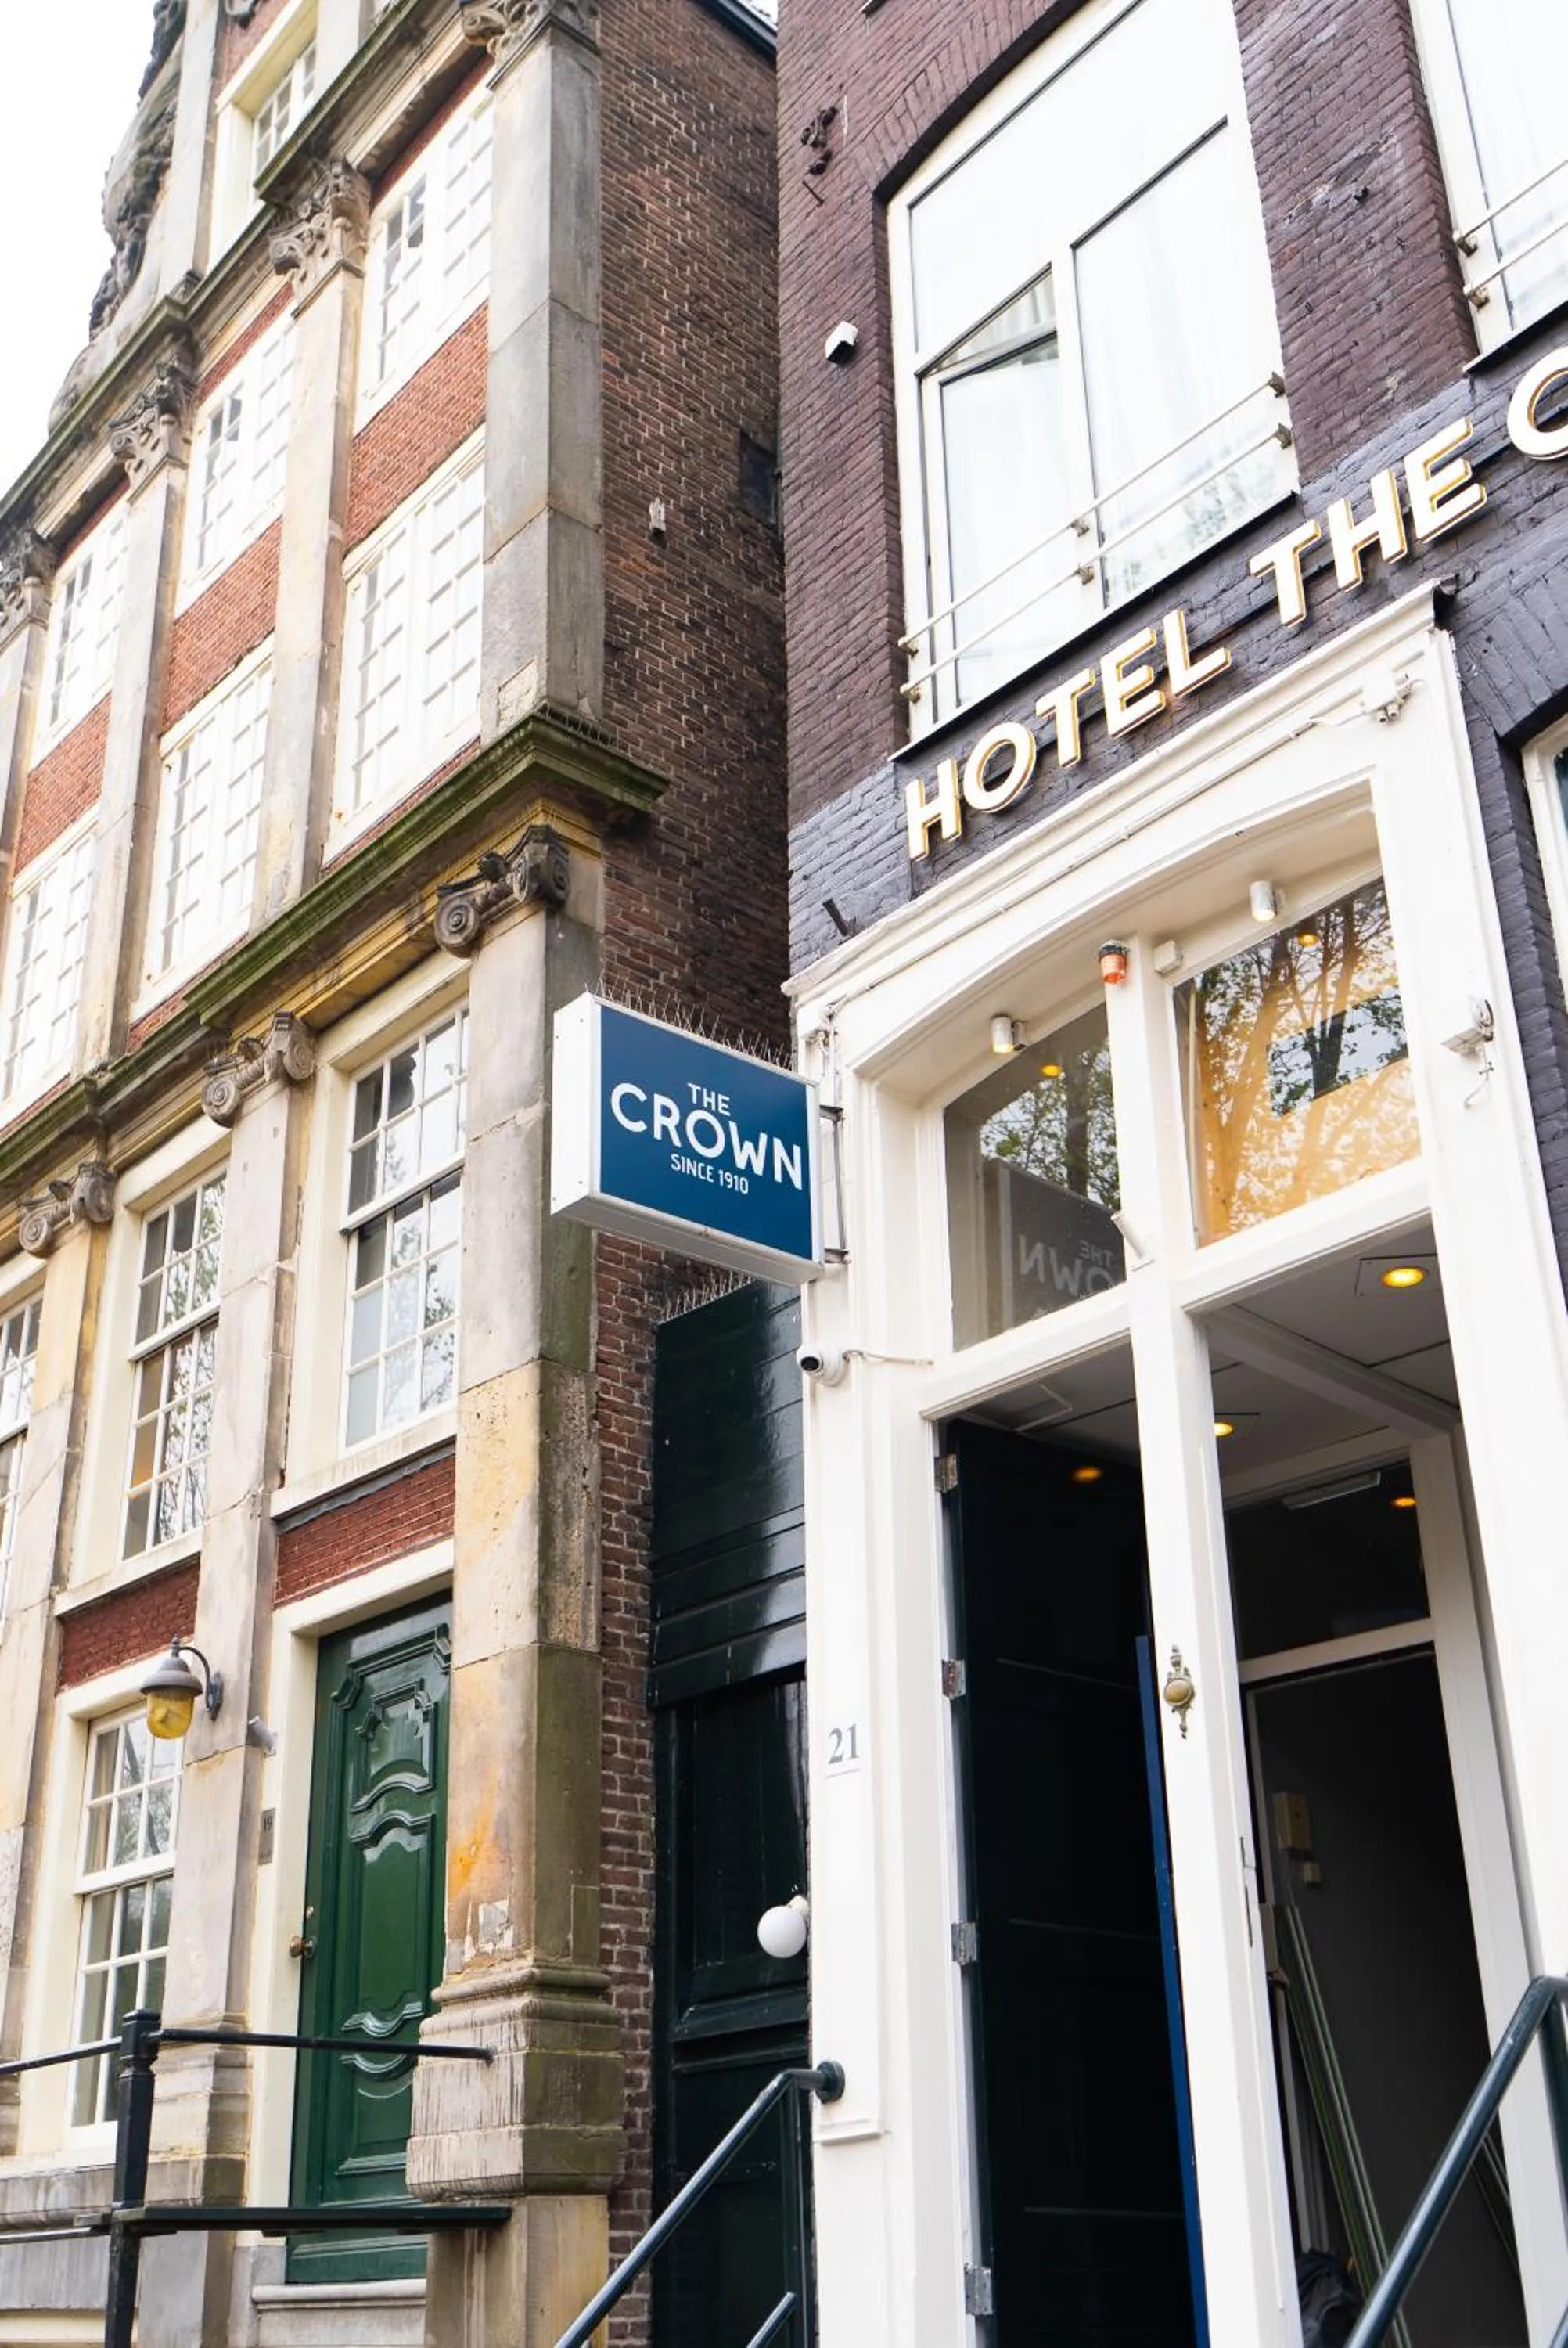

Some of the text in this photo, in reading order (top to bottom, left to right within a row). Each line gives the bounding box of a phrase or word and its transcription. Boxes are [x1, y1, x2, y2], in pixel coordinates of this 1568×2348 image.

[904, 609, 1231, 861] HOTEL
[1251, 418, 1487, 628] THE
[688, 1082, 731, 1115] THE
[610, 1082, 803, 1190] CROWN
[671, 1153, 749, 1194] SINCE 1910
[828, 1723, 861, 1765] 21
